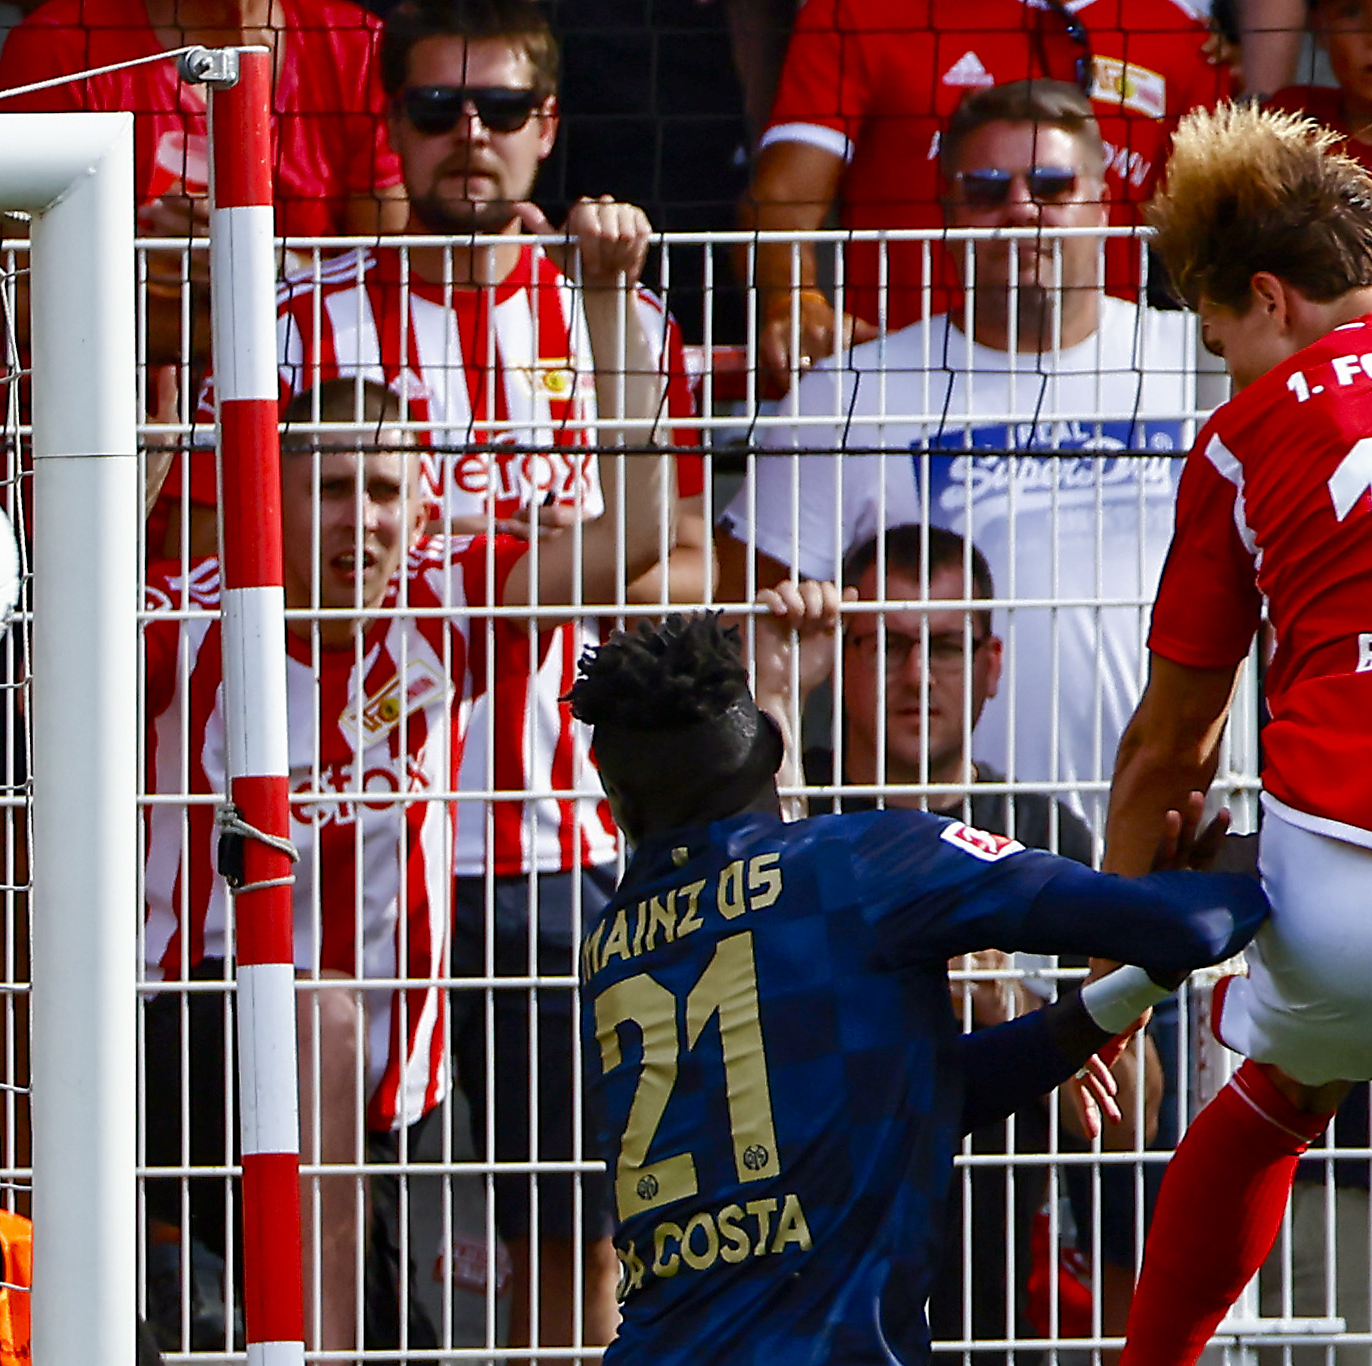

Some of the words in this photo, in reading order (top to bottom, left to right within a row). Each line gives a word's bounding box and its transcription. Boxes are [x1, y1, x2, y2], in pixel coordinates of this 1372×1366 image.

[1287, 371, 1325, 402] 1.
[290, 757, 431, 826] efox
[582, 879, 707, 986] MAINZ
[594, 930, 781, 1223] 21
[652, 1194, 813, 1278] COSTA
